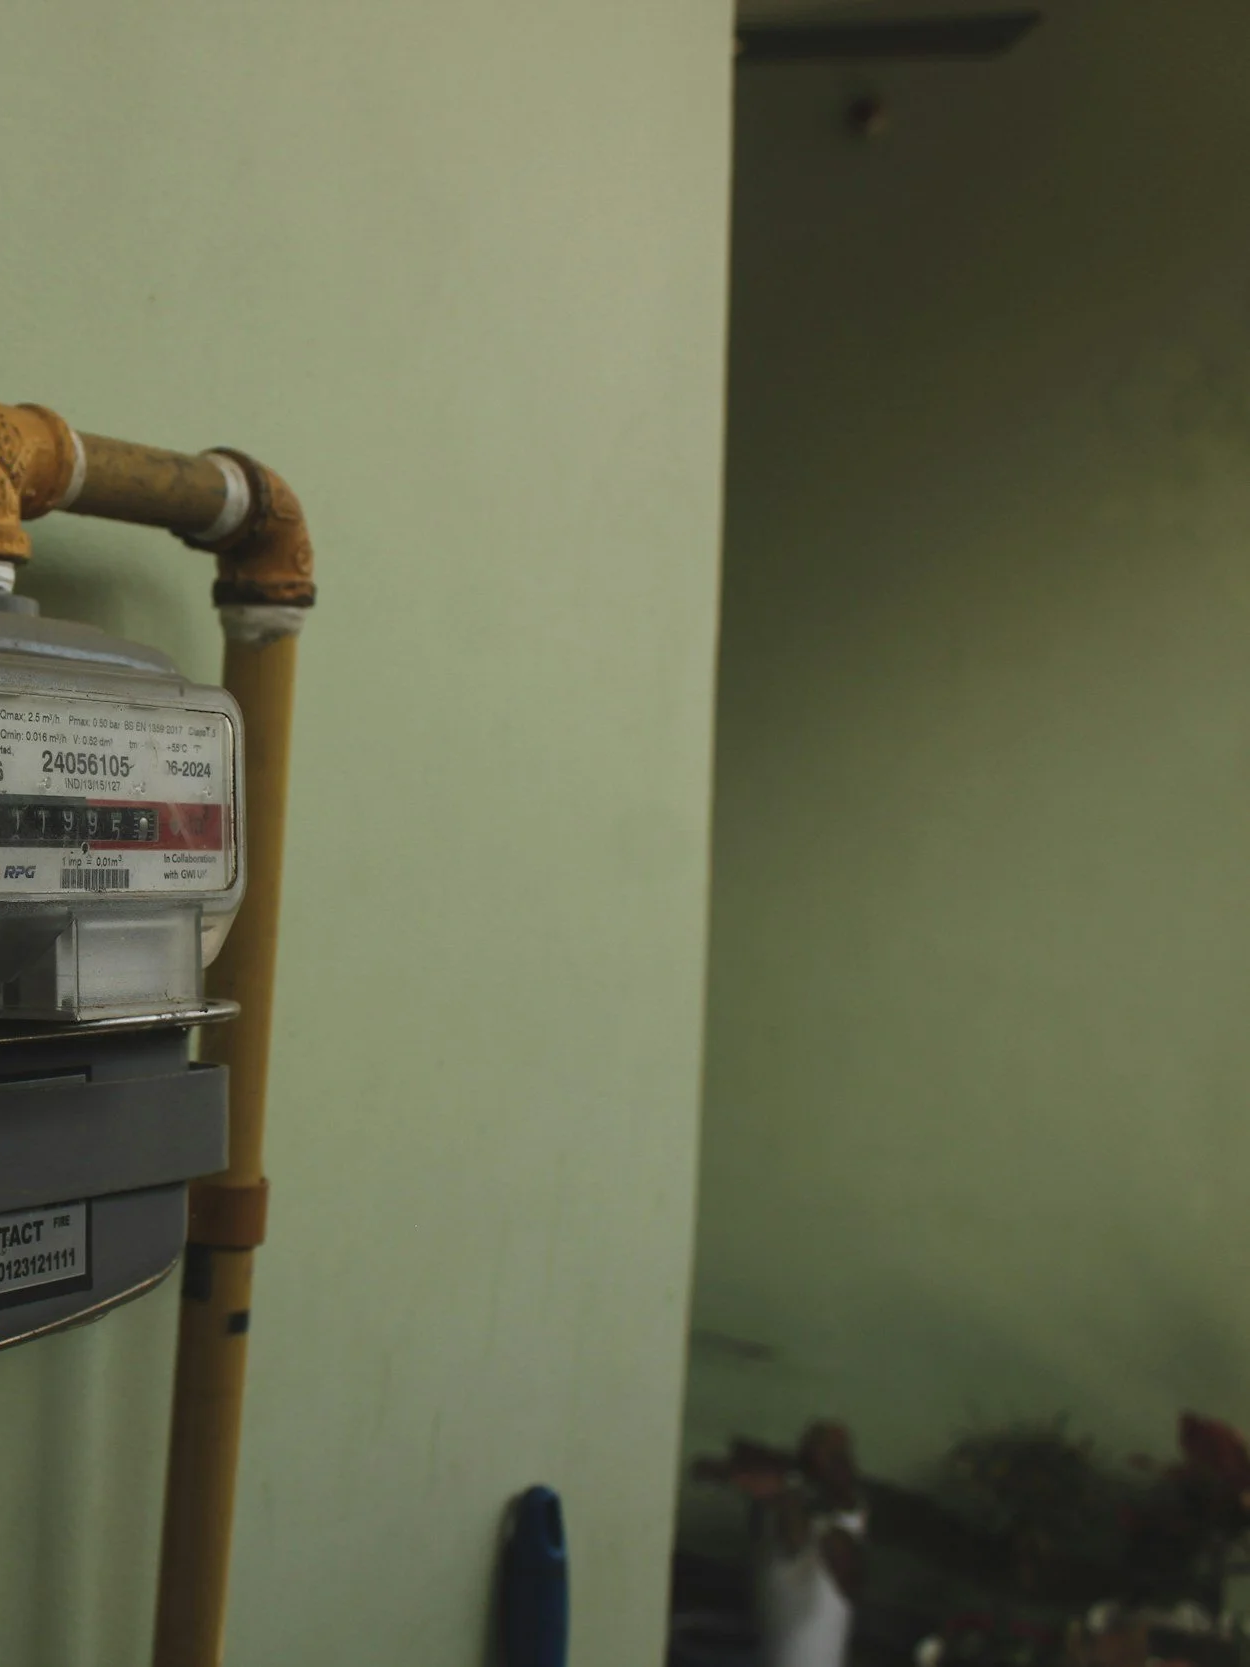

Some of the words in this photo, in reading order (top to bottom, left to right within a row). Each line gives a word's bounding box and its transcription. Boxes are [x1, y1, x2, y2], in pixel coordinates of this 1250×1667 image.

[28, 712, 40, 722] 2.5
[136, 721, 147, 732] EN
[26, 731, 48, 742] 0.016
[42, 750, 130, 777] 24056105
[64, 777, 121, 792] IND/13/15/127
[163, 853, 171, 863] In
[4, 864, 37, 879] RPG
[163, 869, 179, 880] with
[181, 869, 196, 879] GWI
[53, 1215, 71, 1228] FIRE
